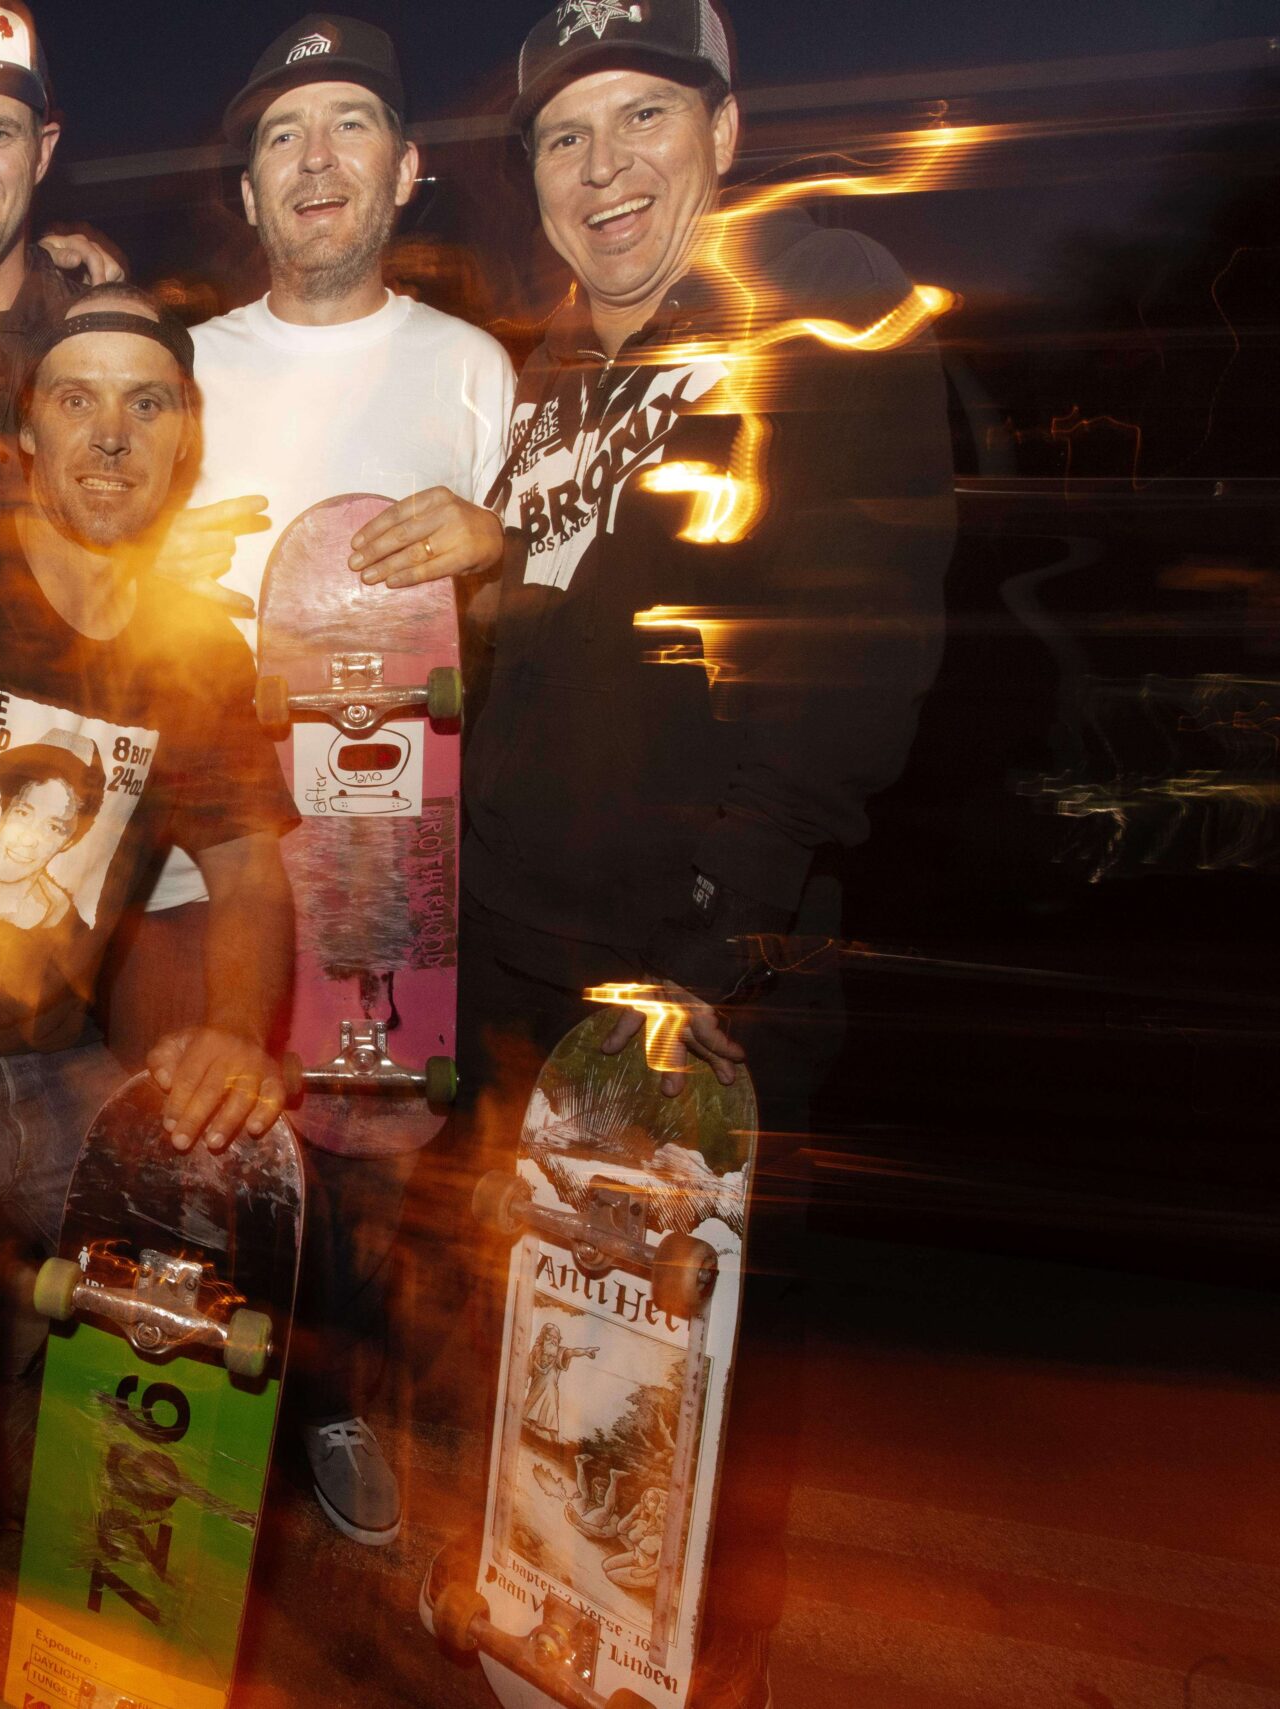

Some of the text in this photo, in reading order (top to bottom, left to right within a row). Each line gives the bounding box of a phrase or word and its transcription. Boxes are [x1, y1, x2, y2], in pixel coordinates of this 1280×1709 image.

[529, 536, 555, 557] LOS
[36, 1628, 91, 1666] Exposure
[608, 1645, 680, 1695] Linden
